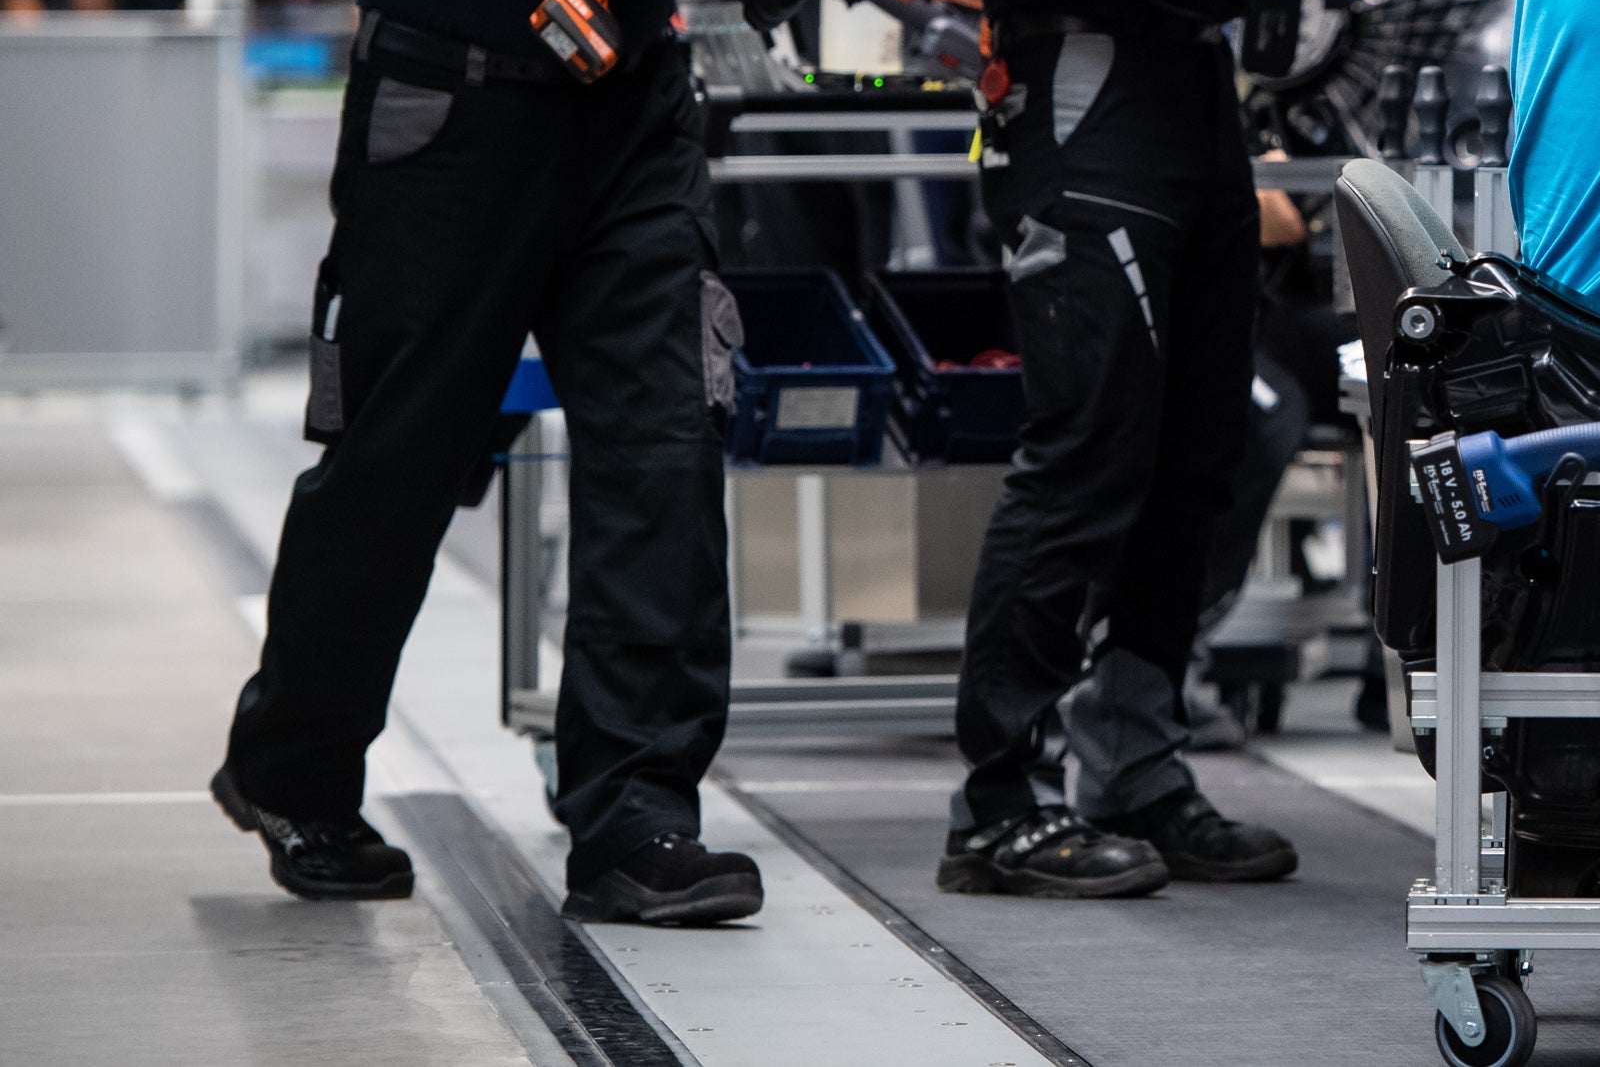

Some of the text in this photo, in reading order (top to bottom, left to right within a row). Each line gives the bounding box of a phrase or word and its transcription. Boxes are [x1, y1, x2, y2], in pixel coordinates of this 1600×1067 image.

[1440, 460, 1453, 477] 18
[1445, 477, 1458, 487] V
[1451, 500, 1467, 520] 5.0
[1457, 523, 1473, 541] Ah
